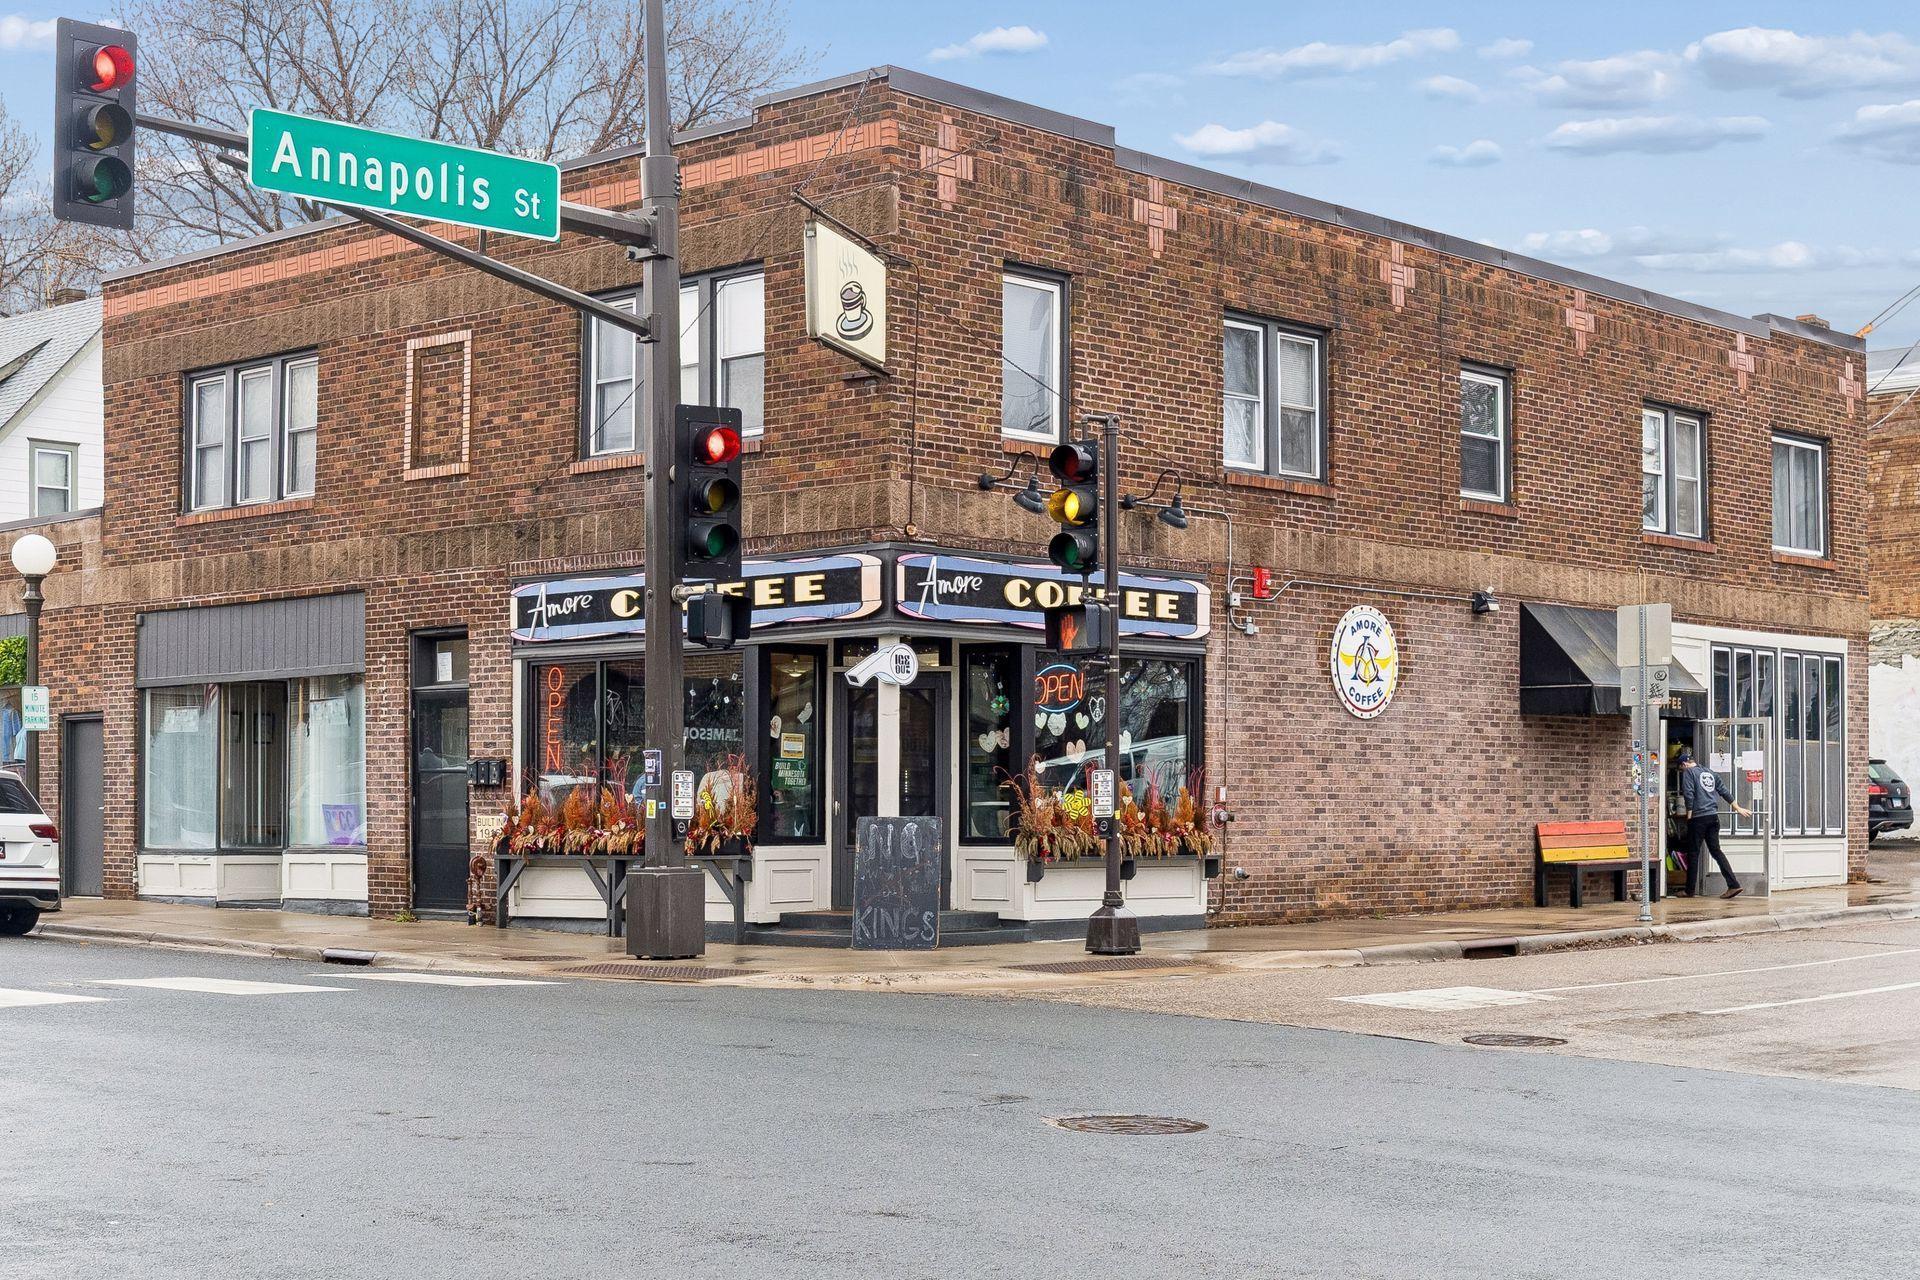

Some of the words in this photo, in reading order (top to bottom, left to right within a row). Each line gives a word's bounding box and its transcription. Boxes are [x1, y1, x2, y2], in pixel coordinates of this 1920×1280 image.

[271, 130, 490, 211] Annapolis
[513, 188, 541, 220] St
[917, 556, 983, 616] Amore
[528, 583, 593, 640] Amore
[1350, 619, 1383, 638] AMORE
[1034, 672, 1085, 705] OPEN
[1348, 685, 1385, 706] COFFEE
[25, 704, 46, 713] MINUTE
[25, 716, 47, 724] PARKING
[546, 666, 563, 774] OPEN
[775, 761, 791, 770] BUILD
[477, 817, 493, 826] BUILT
[856, 904, 936, 941] KINGS
